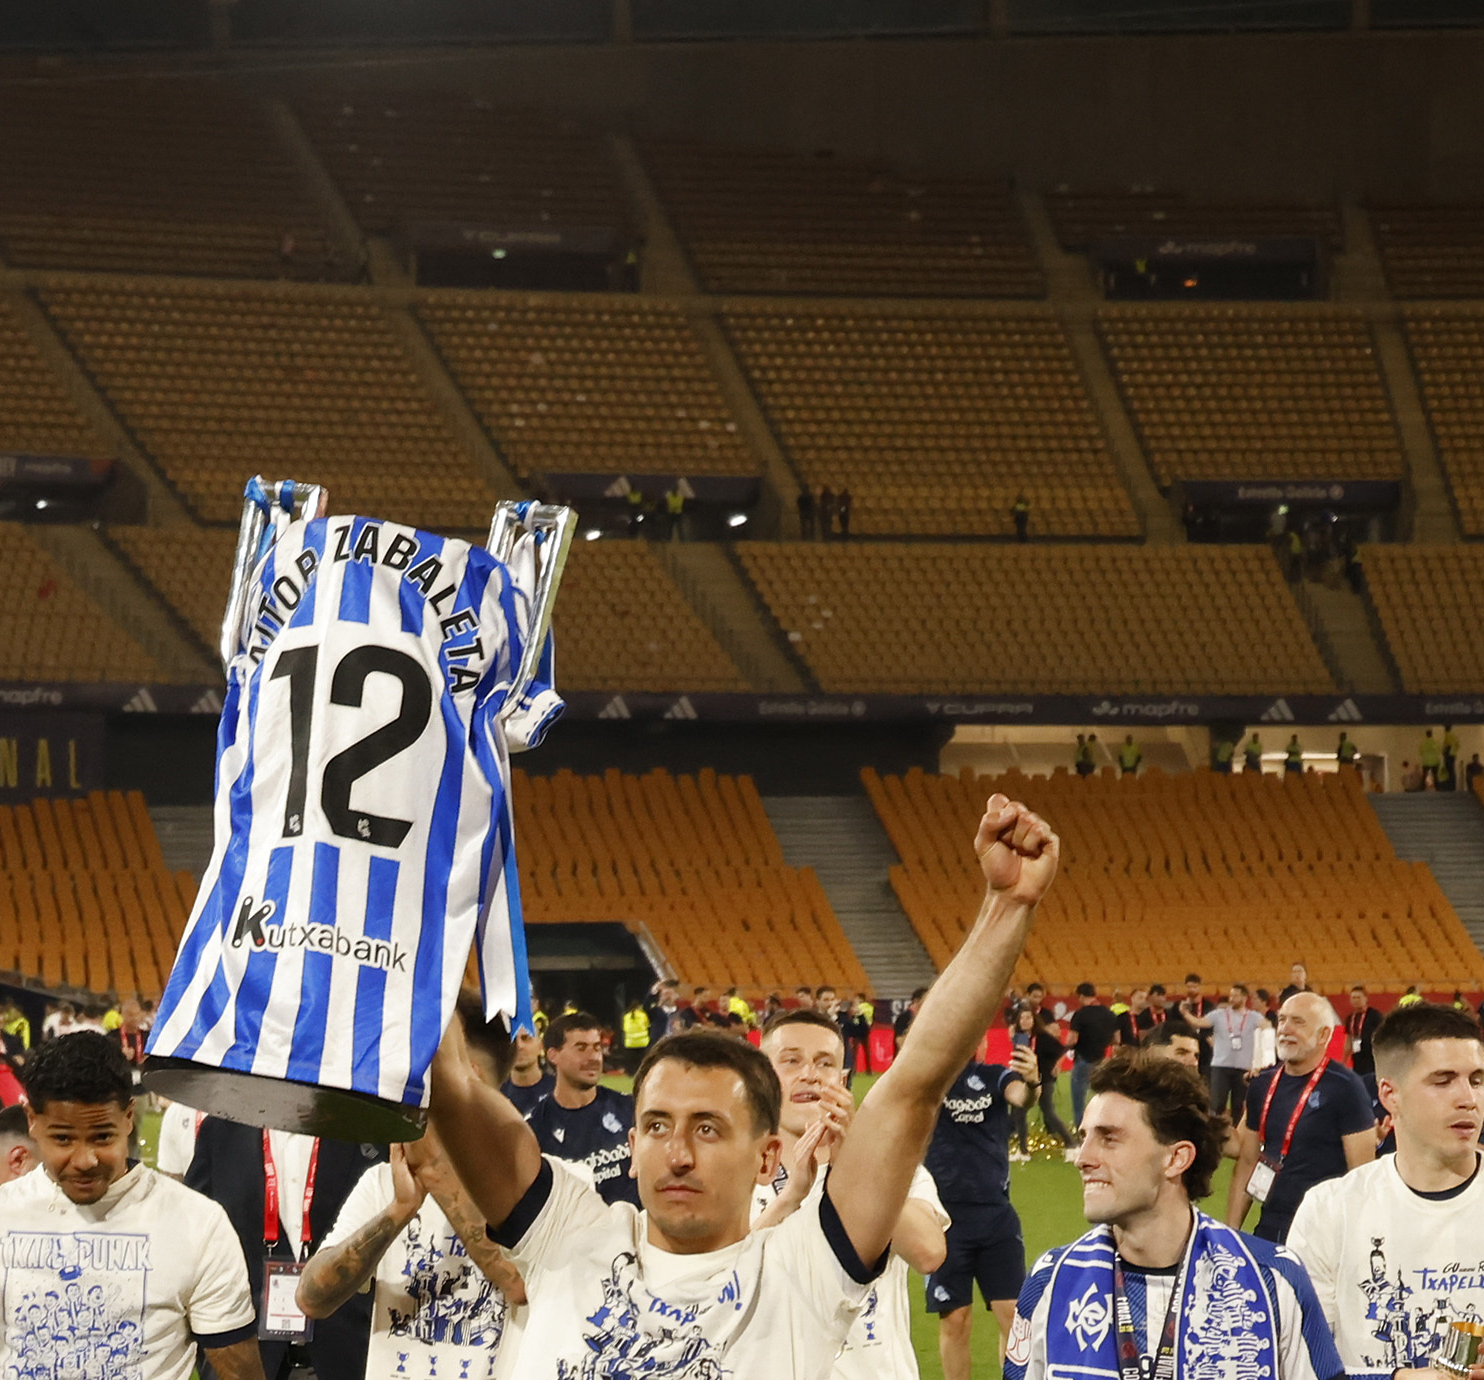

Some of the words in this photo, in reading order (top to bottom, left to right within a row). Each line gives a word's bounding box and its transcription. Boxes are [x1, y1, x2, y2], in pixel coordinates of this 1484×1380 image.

[333, 522, 485, 695] ZABALETA
[15, 687, 93, 705] mapfre
[1122, 702, 1200, 718] mapfre
[269, 644, 433, 850] 12
[231, 895, 409, 973] Kutxabank
